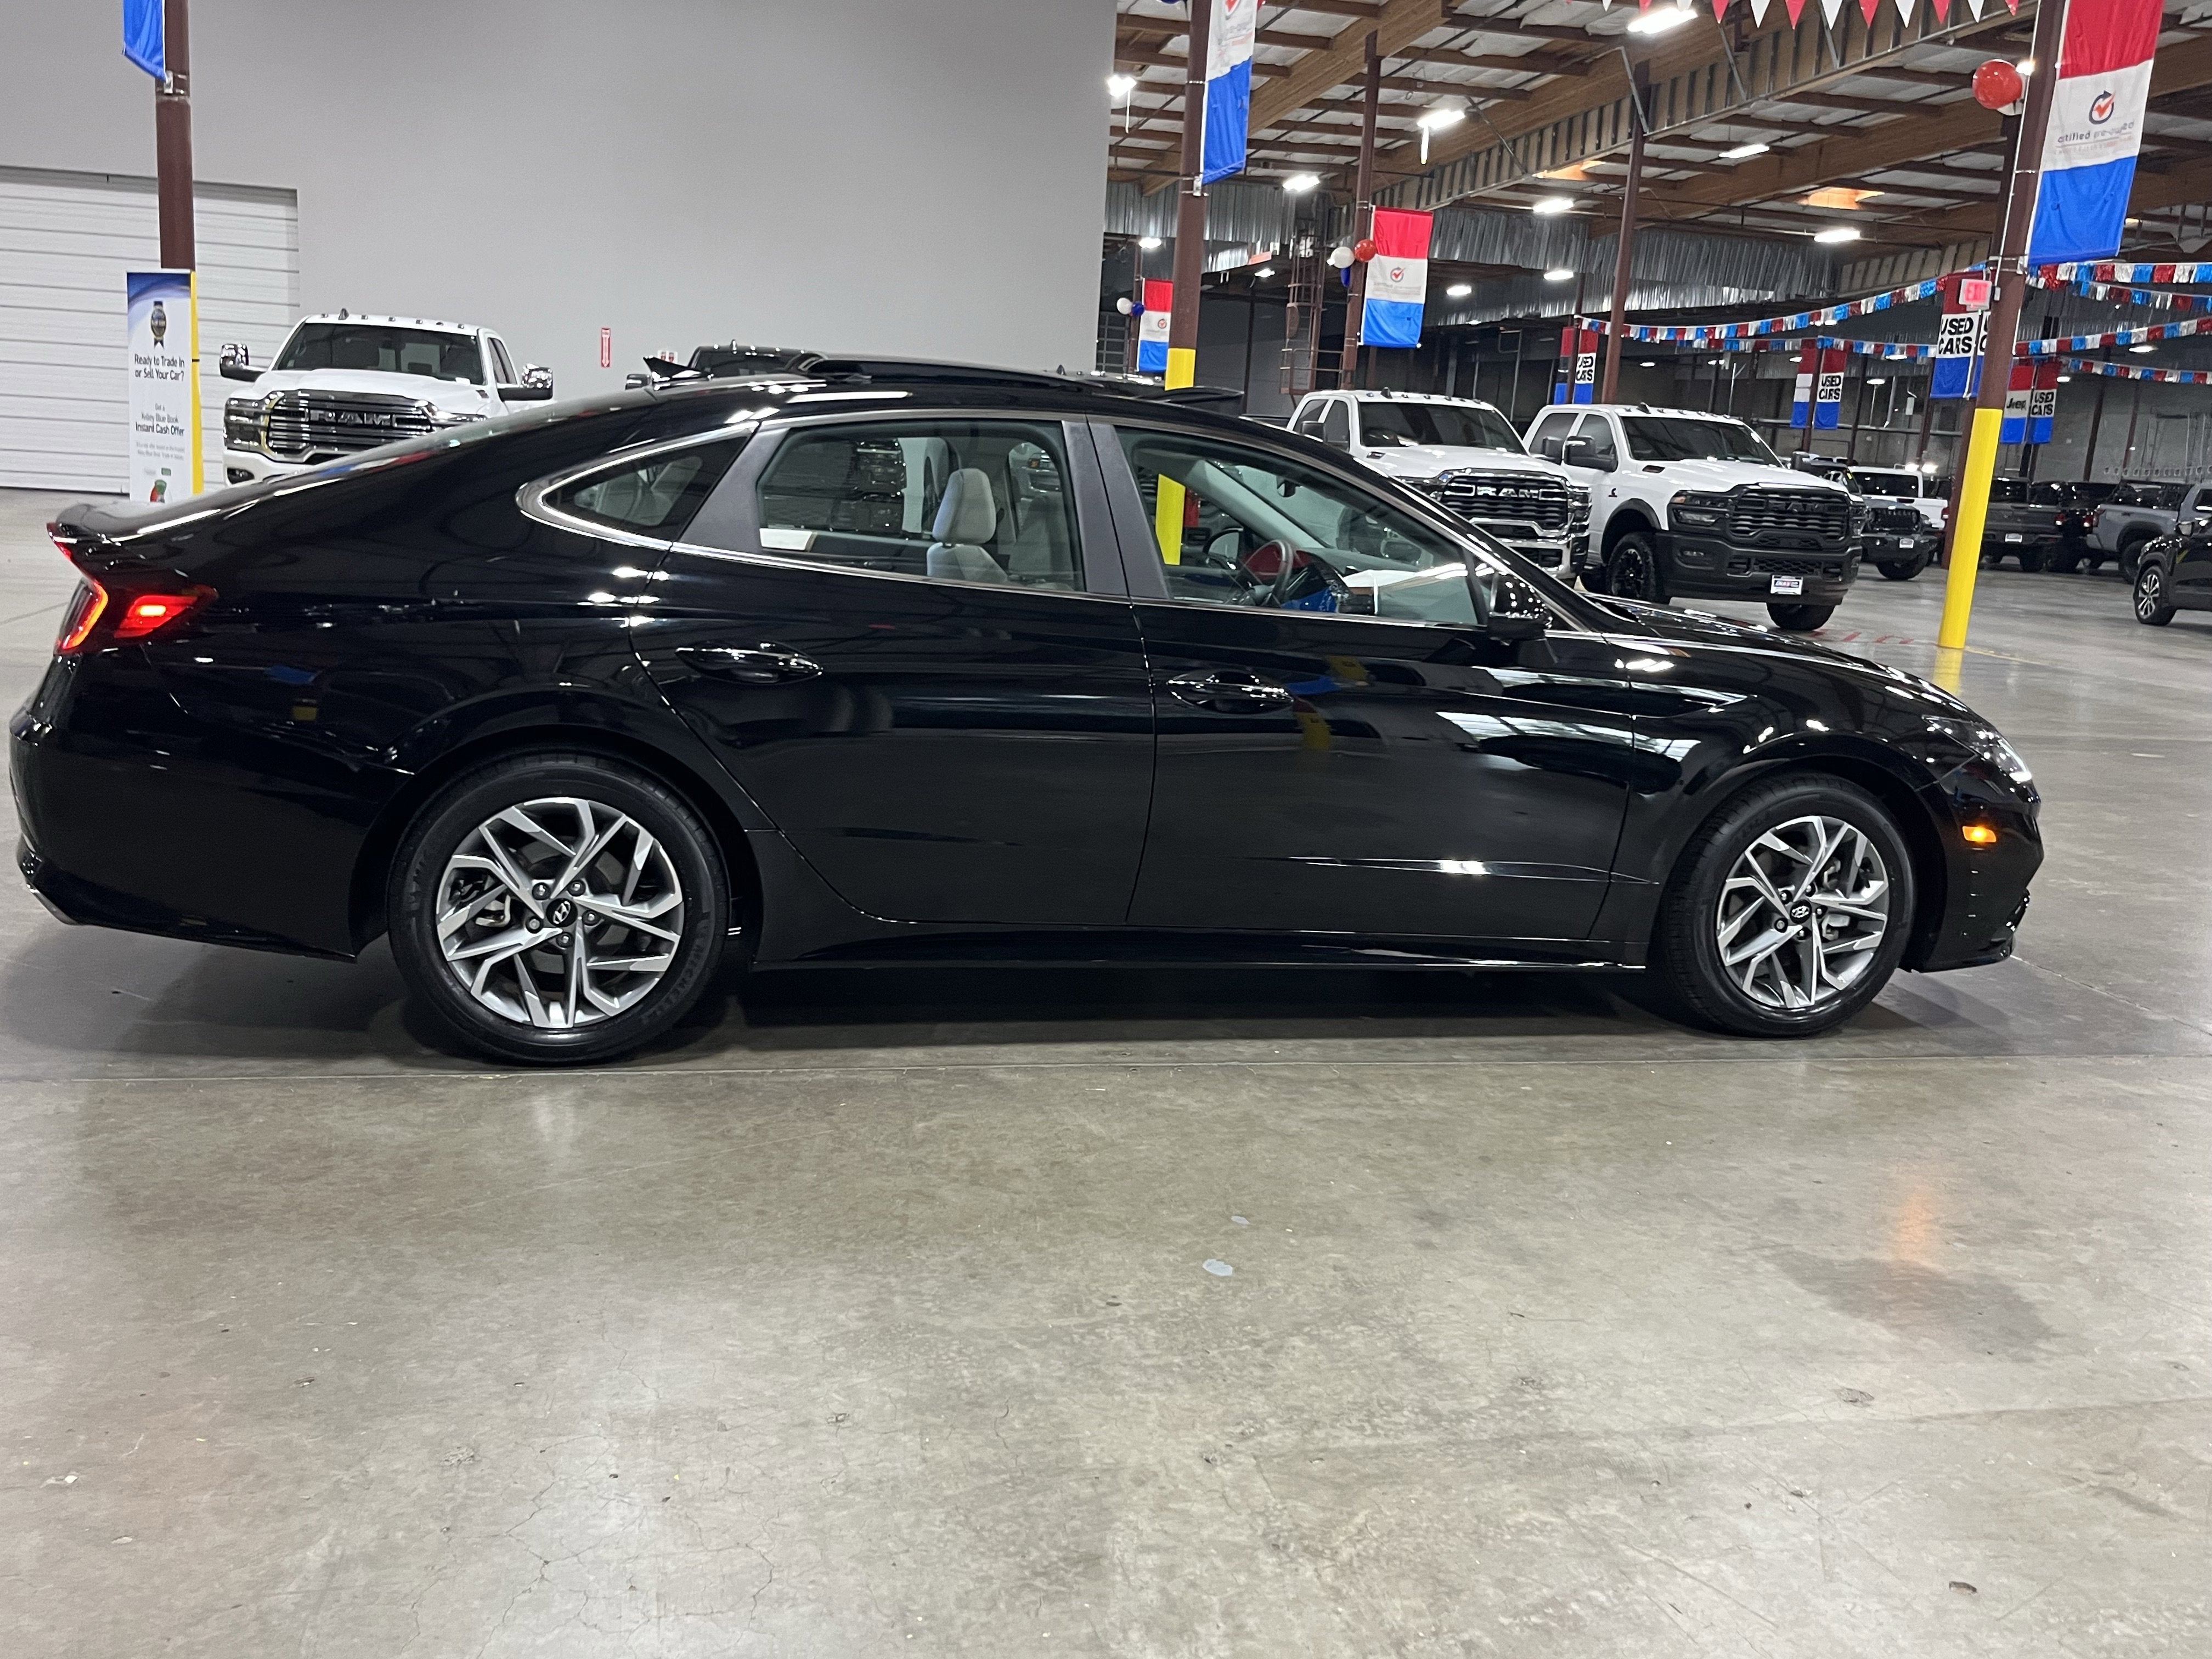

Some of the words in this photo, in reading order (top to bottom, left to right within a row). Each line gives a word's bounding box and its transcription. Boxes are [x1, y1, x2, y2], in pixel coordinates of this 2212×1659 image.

[1940, 317, 1974, 336] USED
[1938, 336, 1973, 355] CARS
[135, 353, 152, 368] Ready
[154, 356, 160, 366] to
[161, 356, 178, 367] Trade
[179, 356, 184, 368] In
[135, 369, 142, 377] or
[144, 367, 154, 379] Sell
[155, 368, 169, 380] Your
[170, 370, 184, 382] Car?
[1821, 375, 1842, 387] USED
[310, 410, 391, 426] RAM
[136, 421, 154, 433] Instant
[156, 424, 170, 434] Cash
[171, 425, 184, 436] Offer
[1477, 486, 1538, 499] RAM
